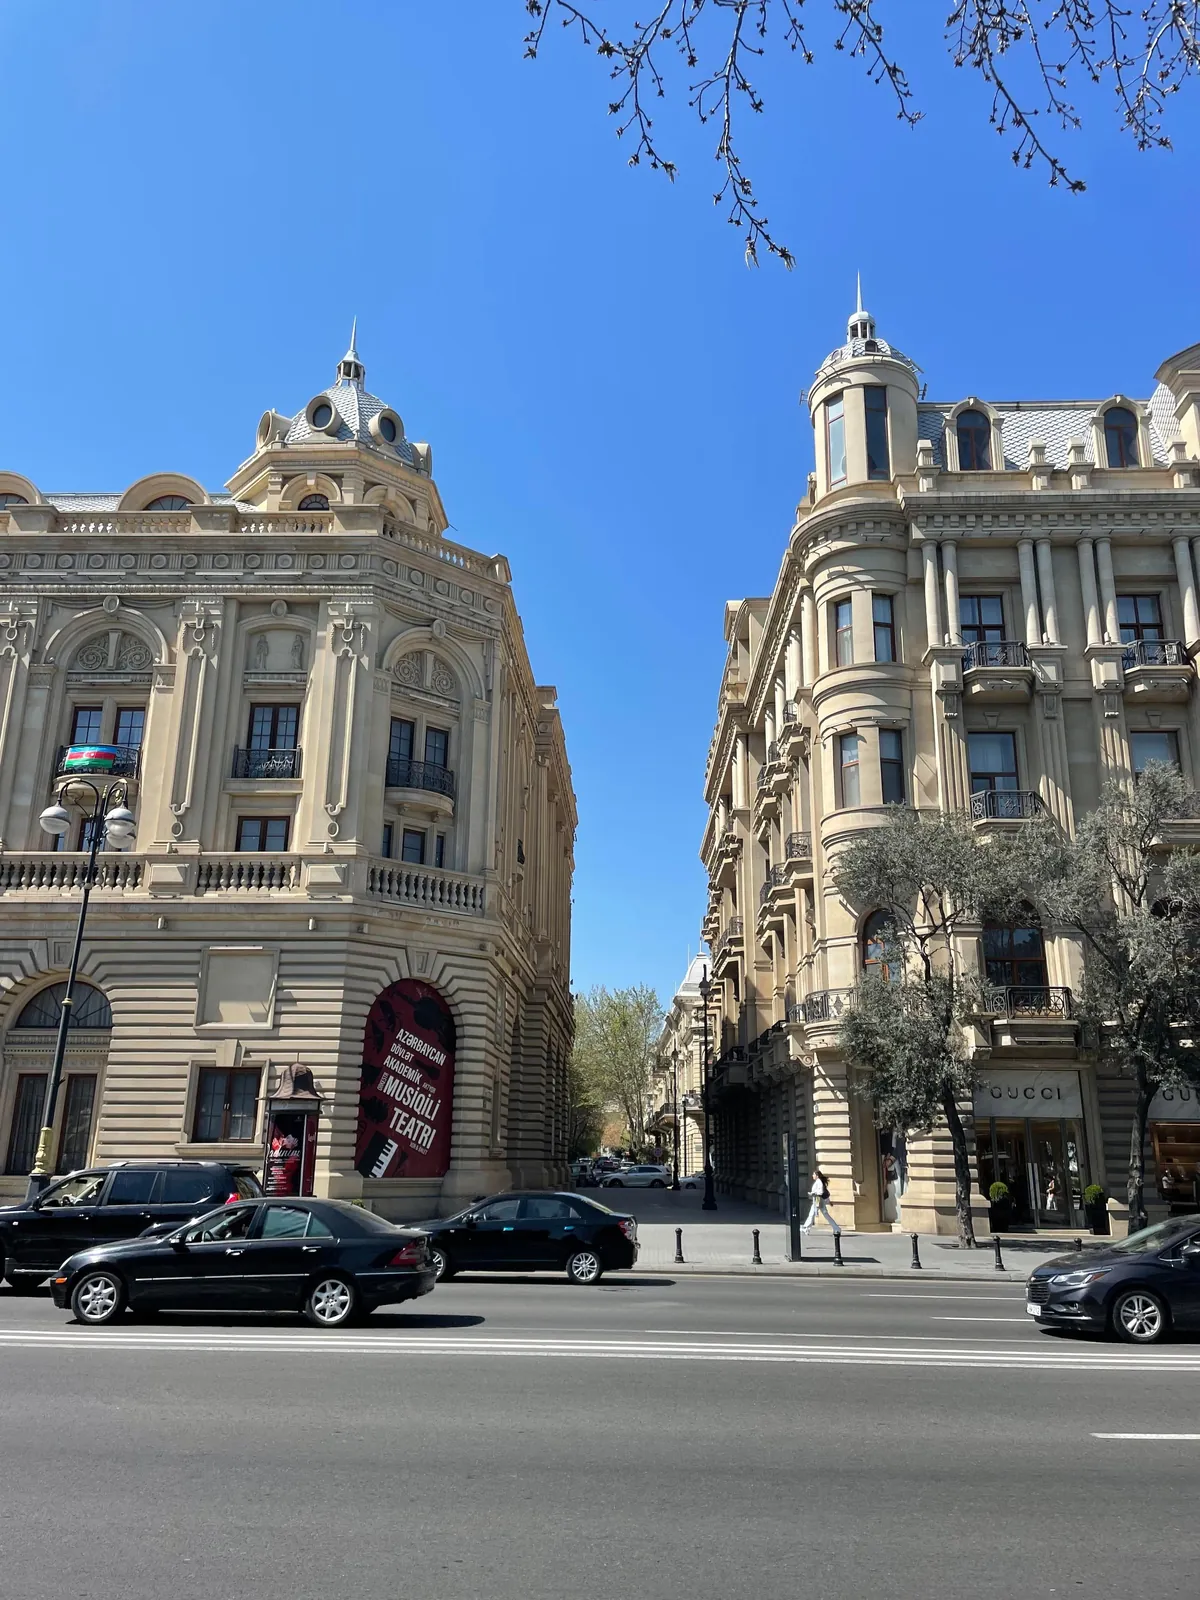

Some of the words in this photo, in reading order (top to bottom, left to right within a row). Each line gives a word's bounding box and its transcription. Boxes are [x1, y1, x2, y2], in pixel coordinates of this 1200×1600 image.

[390, 1043, 415, 1063] DÖVLƏT
[395, 1028, 447, 1066] AZƏRBAYCAN
[383, 1055, 423, 1085] AKADEMİK
[382, 1075, 442, 1121] MUSİQİLİ
[990, 1086, 1061, 1100] GUCCI
[389, 1106, 437, 1149] TEATRI
